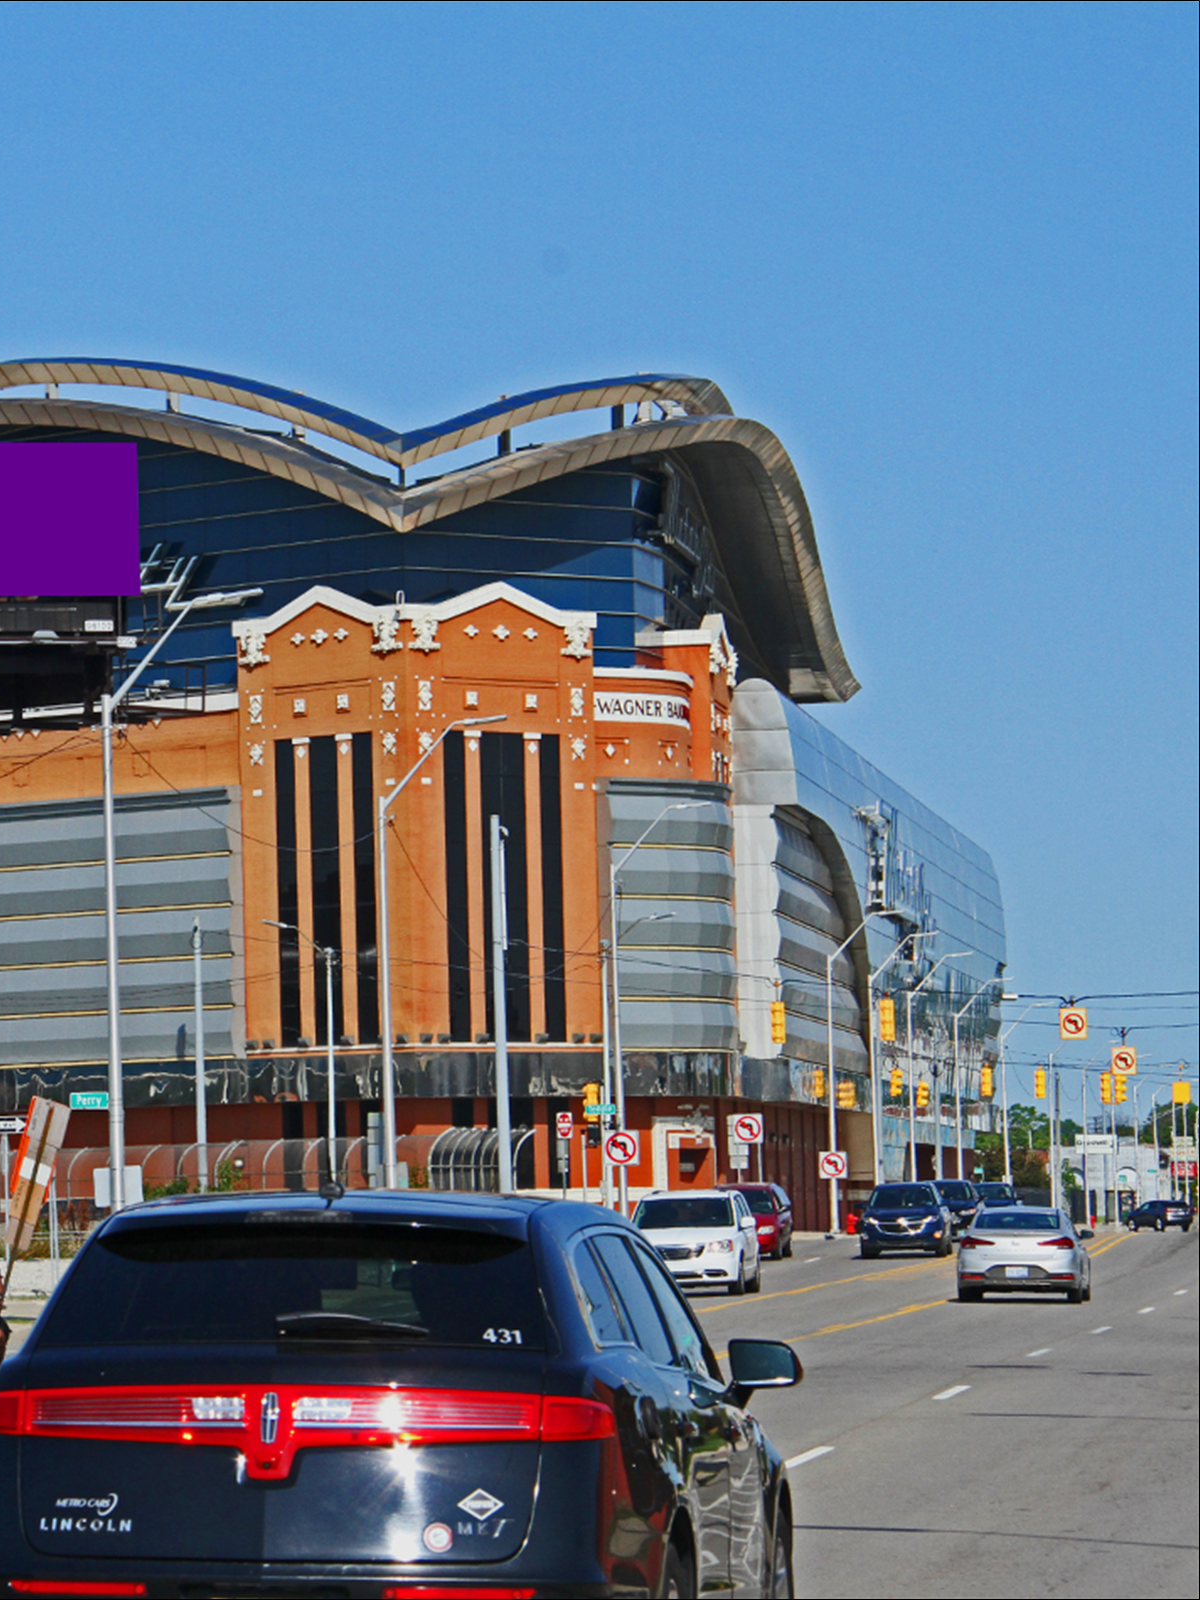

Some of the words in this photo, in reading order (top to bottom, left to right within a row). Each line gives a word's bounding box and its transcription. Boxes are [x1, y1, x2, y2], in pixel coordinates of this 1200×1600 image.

[596, 699, 662, 717] WAGNER
[76, 1095, 103, 1108] Perry
[482, 1328, 523, 1344] 431
[55, 1498, 87, 1508] METRO
[87, 1498, 111, 1508] CARS
[40, 1518, 133, 1532] LINCOLN
